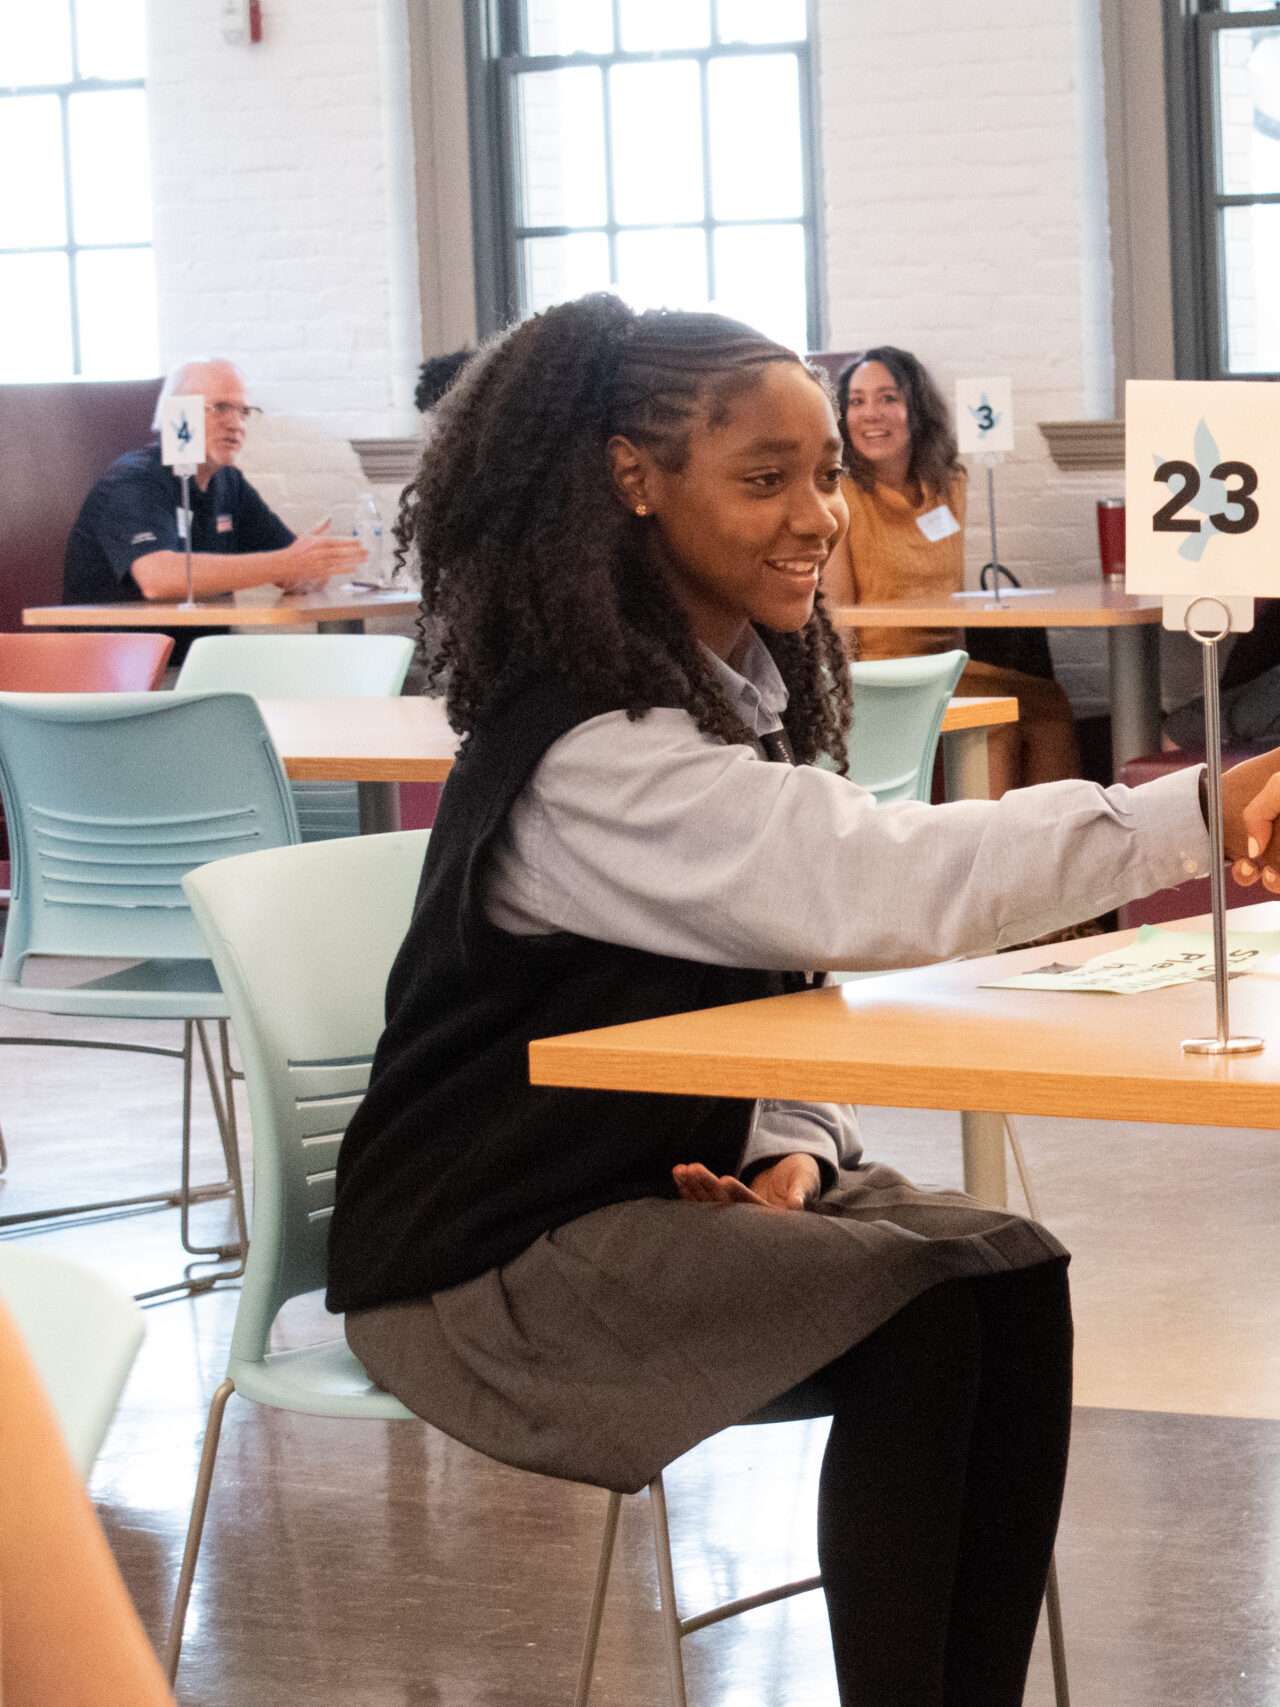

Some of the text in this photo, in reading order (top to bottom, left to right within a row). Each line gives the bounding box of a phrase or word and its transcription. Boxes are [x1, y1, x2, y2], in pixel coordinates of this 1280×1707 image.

[977, 405, 994, 430] 3
[177, 421, 191, 443] 4
[1153, 460, 1260, 534] 23
